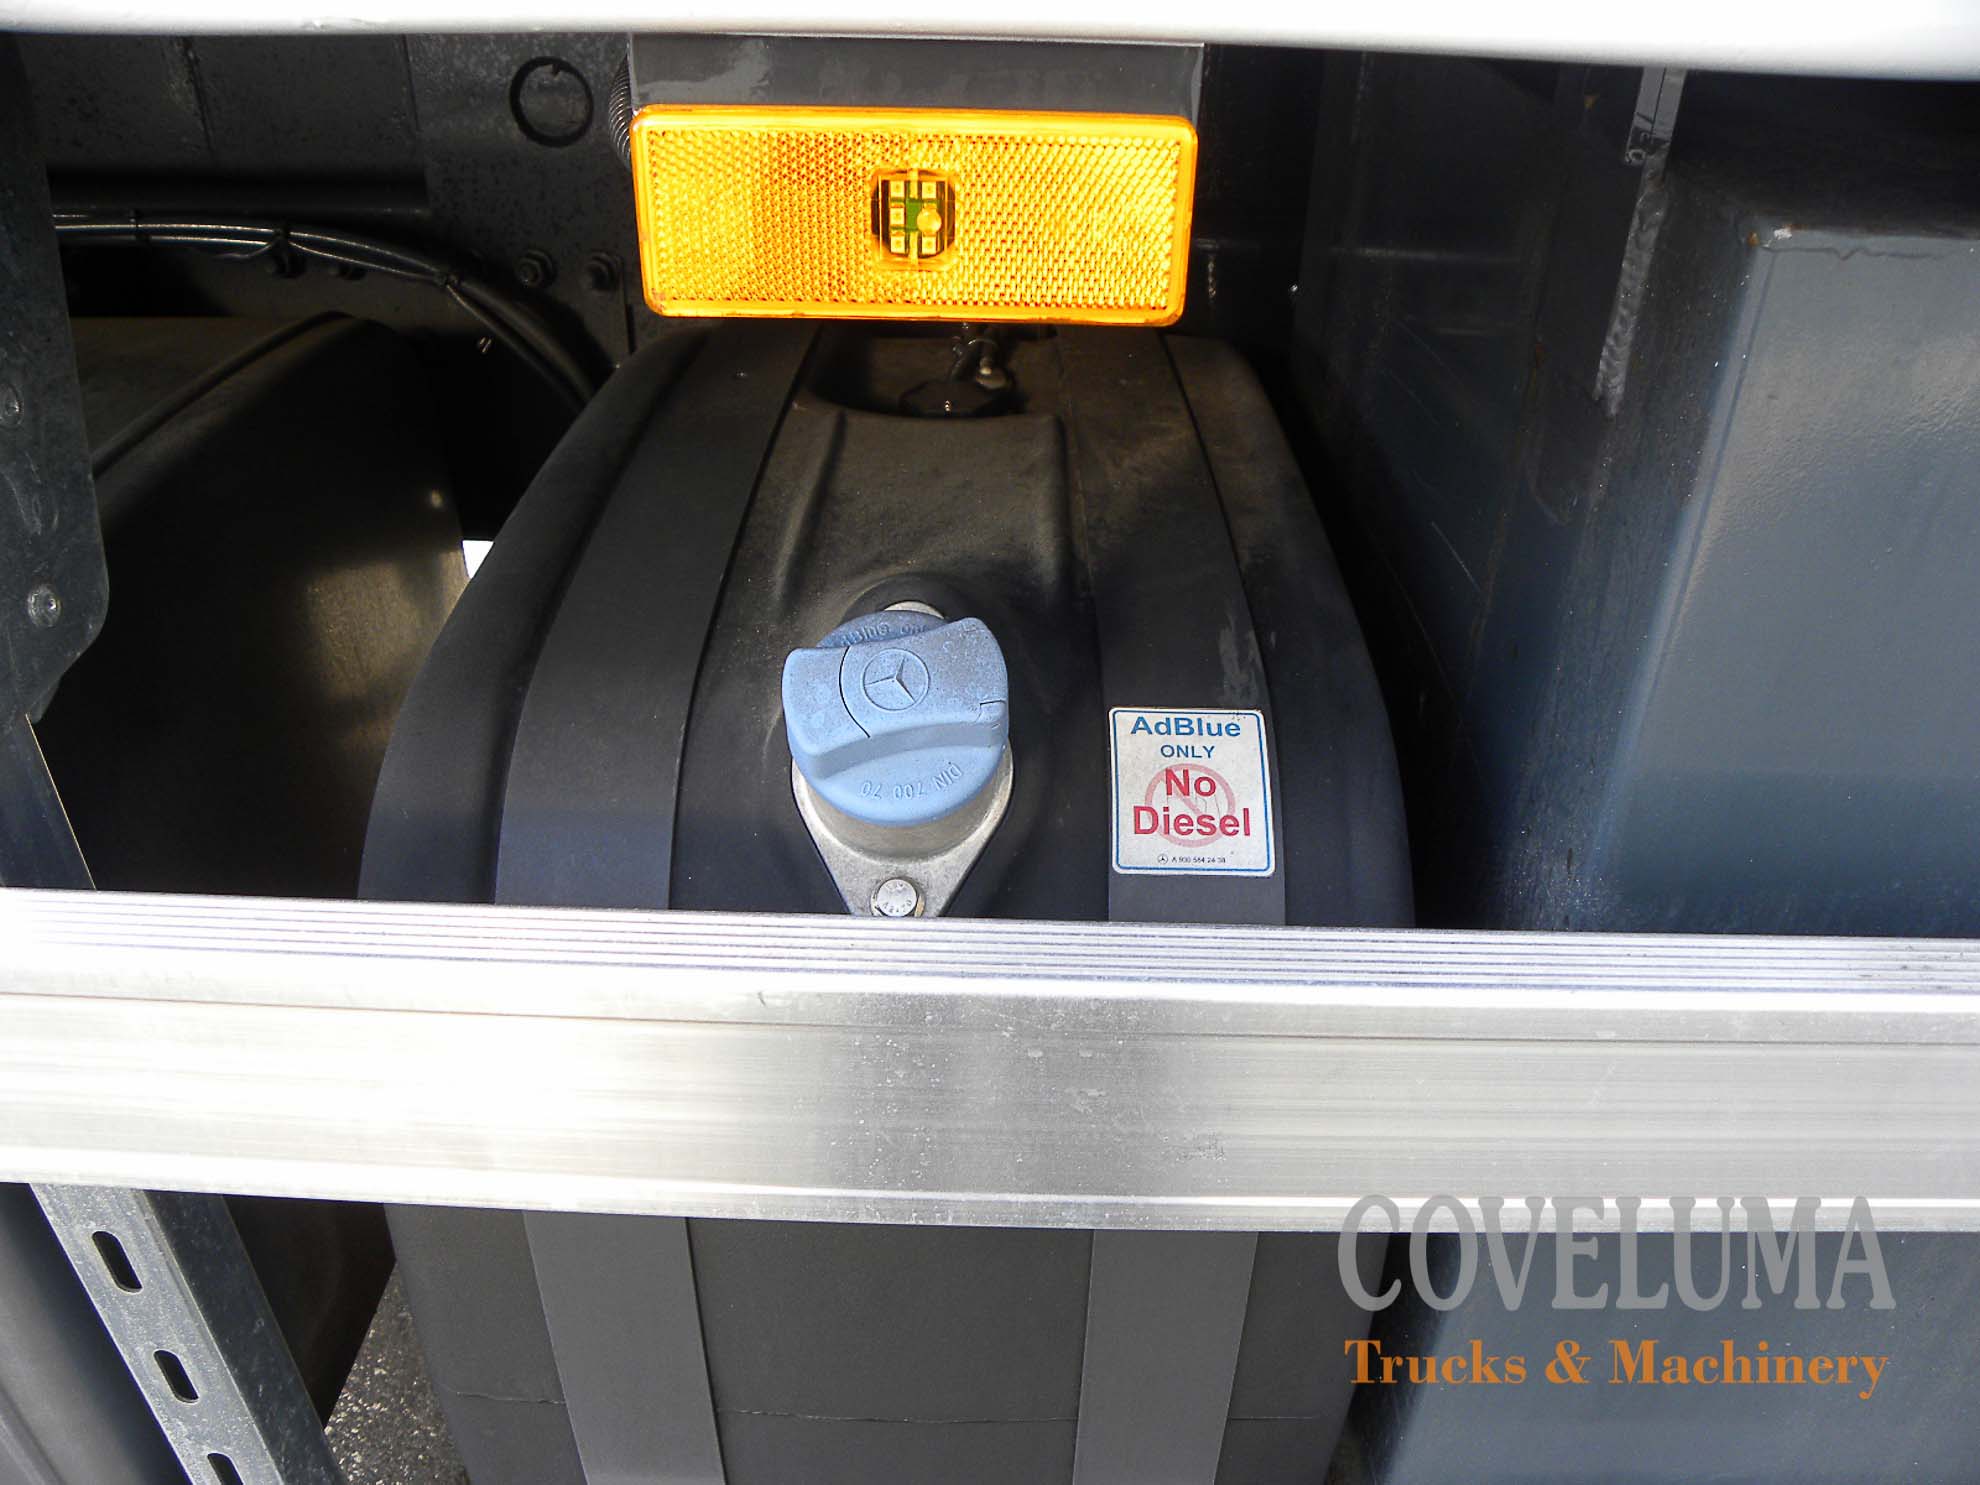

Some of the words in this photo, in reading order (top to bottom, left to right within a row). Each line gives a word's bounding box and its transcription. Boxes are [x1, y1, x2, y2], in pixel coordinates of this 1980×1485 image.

[1130, 716, 1241, 737] AdBlue
[1160, 744, 1215, 759] ONLY
[932, 764, 962, 791] DIN
[1165, 768, 1217, 797] No
[861, 781, 882, 799] 70
[893, 782, 928, 800] 700
[1133, 805, 1251, 837] Diesel
